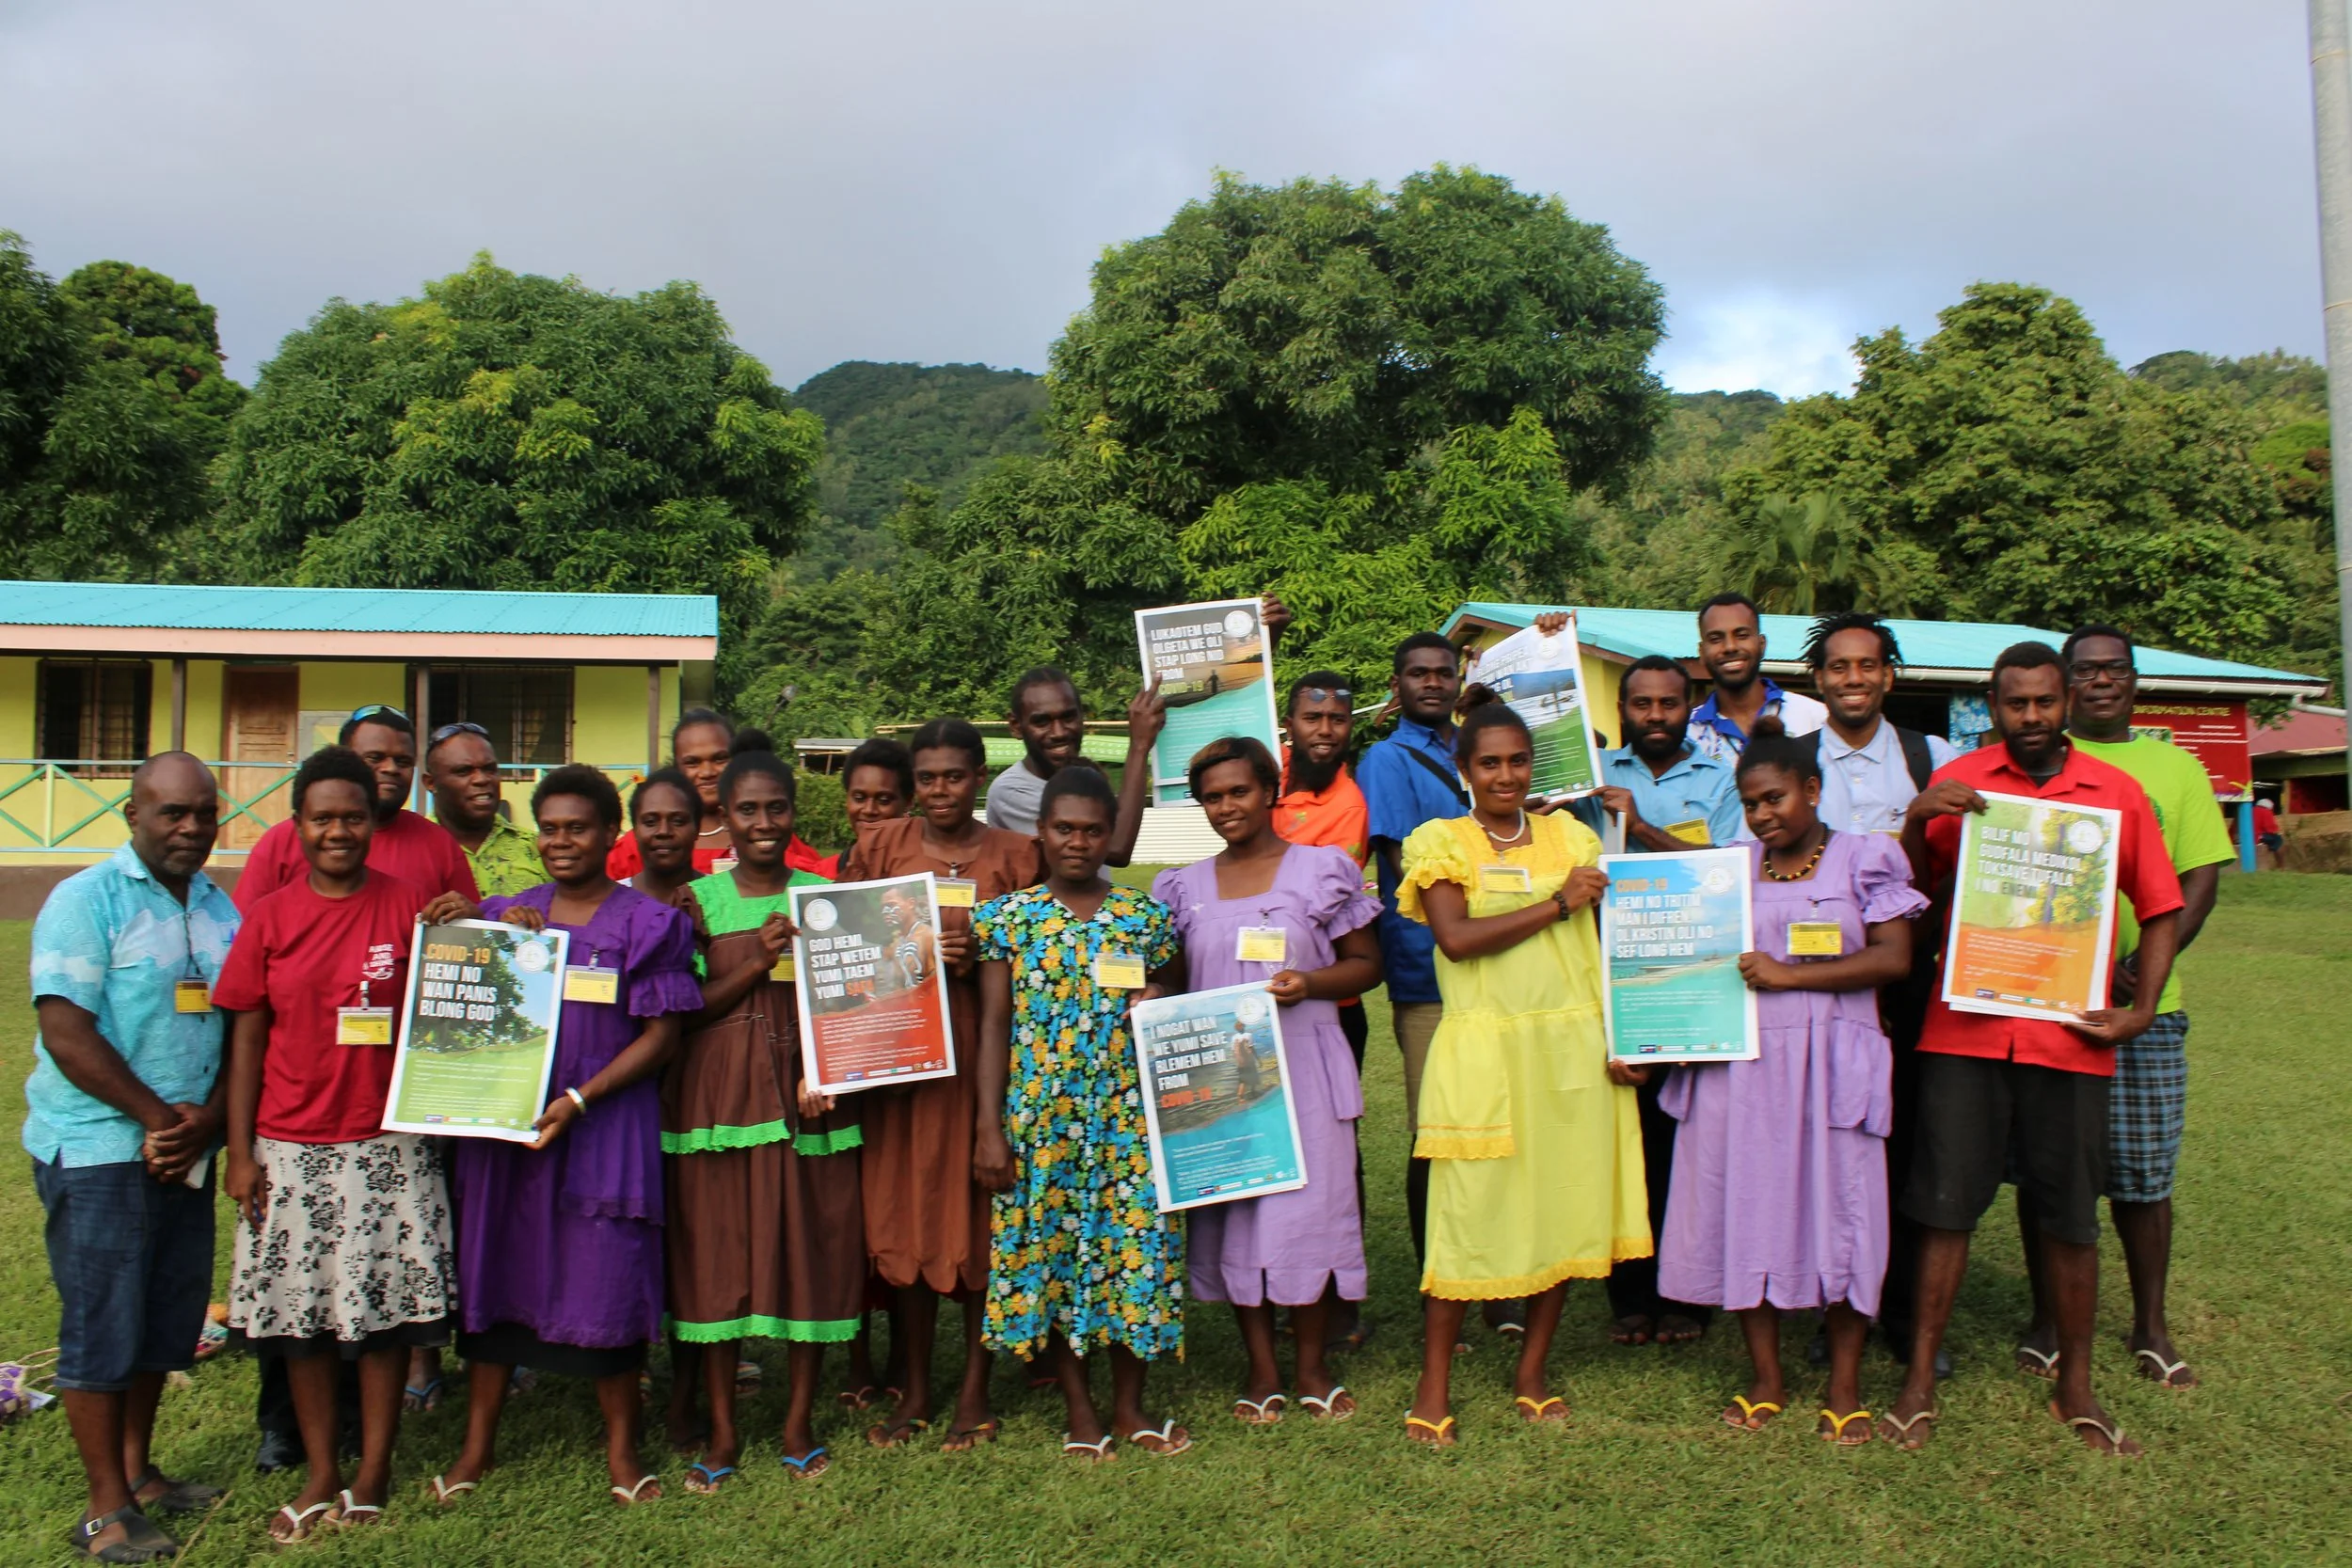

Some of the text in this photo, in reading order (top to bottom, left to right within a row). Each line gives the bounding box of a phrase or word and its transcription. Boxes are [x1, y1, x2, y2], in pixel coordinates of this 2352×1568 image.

[1153, 637, 1222, 654] OLGETA WE OLI
[1155, 656, 1179, 667] STAP
[1180, 652, 1206, 664] LONG
[1159, 681, 1204, 695] COVID-19
[1982, 827, 2010, 842] BILIF
[1982, 879, 1998, 893] NO
[1616, 896, 1644, 909] HEMI
[1646, 895, 1661, 909] NO
[1617, 912, 1642, 925] MAN
[1644, 912, 1648, 925] I
[1617, 927, 1713, 942] OL KRISTIN OLI NO
[810, 935, 863, 952] GOD HEMI
[1617, 943, 1694, 958] SEF LONG HEM
[427, 944, 491, 964] COVID-19
[812, 947, 882, 968] STAP WETEM
[425, 964, 483, 983] HEMI NO
[814, 964, 875, 983] YUMI TAEM
[423, 982, 498, 1004] WAN PANIS
[816, 985, 845, 999] YUMI
[421, 1001, 496, 1022] BLONG GOD
[1151, 1017, 1217, 1039] I NOGAT WAN
[1153, 1032, 1228, 1056] WE YUMI SAVE
[1155, 1050, 1227, 1074] BLEMEM HEM
[1158, 1074, 1190, 1091] FROM
